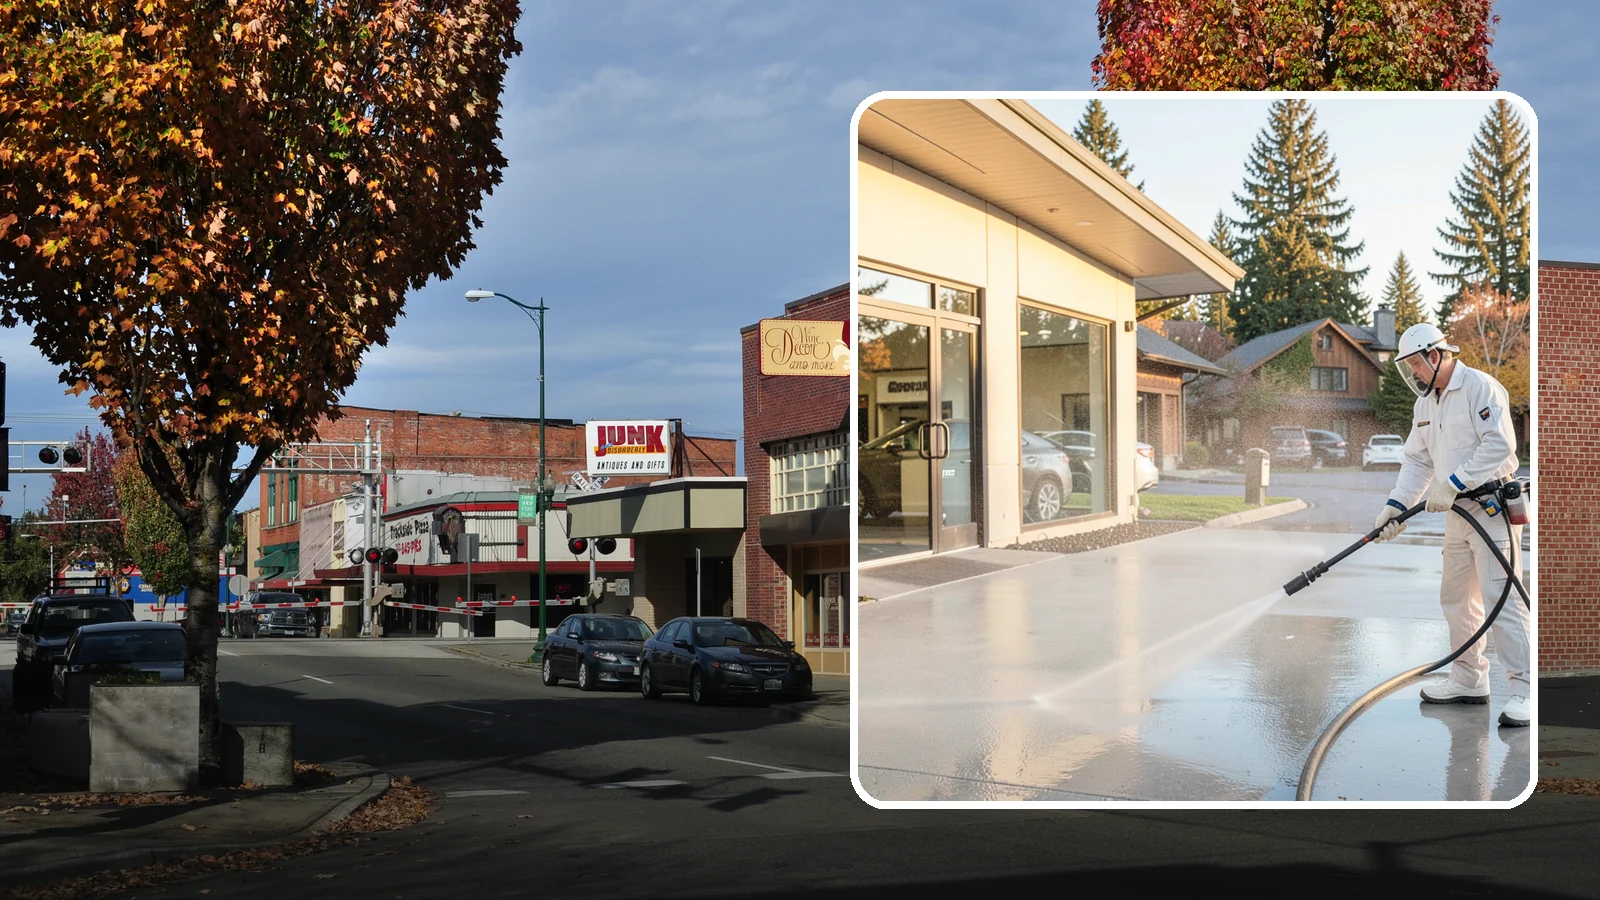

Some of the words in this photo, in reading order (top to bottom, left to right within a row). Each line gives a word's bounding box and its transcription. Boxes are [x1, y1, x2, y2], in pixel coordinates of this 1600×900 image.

[595, 425, 665, 457] JUNK
[607, 445, 646, 454] DISORDERLY
[597, 461, 628, 470] ANTIQUES
[631, 461, 644, 469] AND
[647, 460, 665, 469] GIFTS
